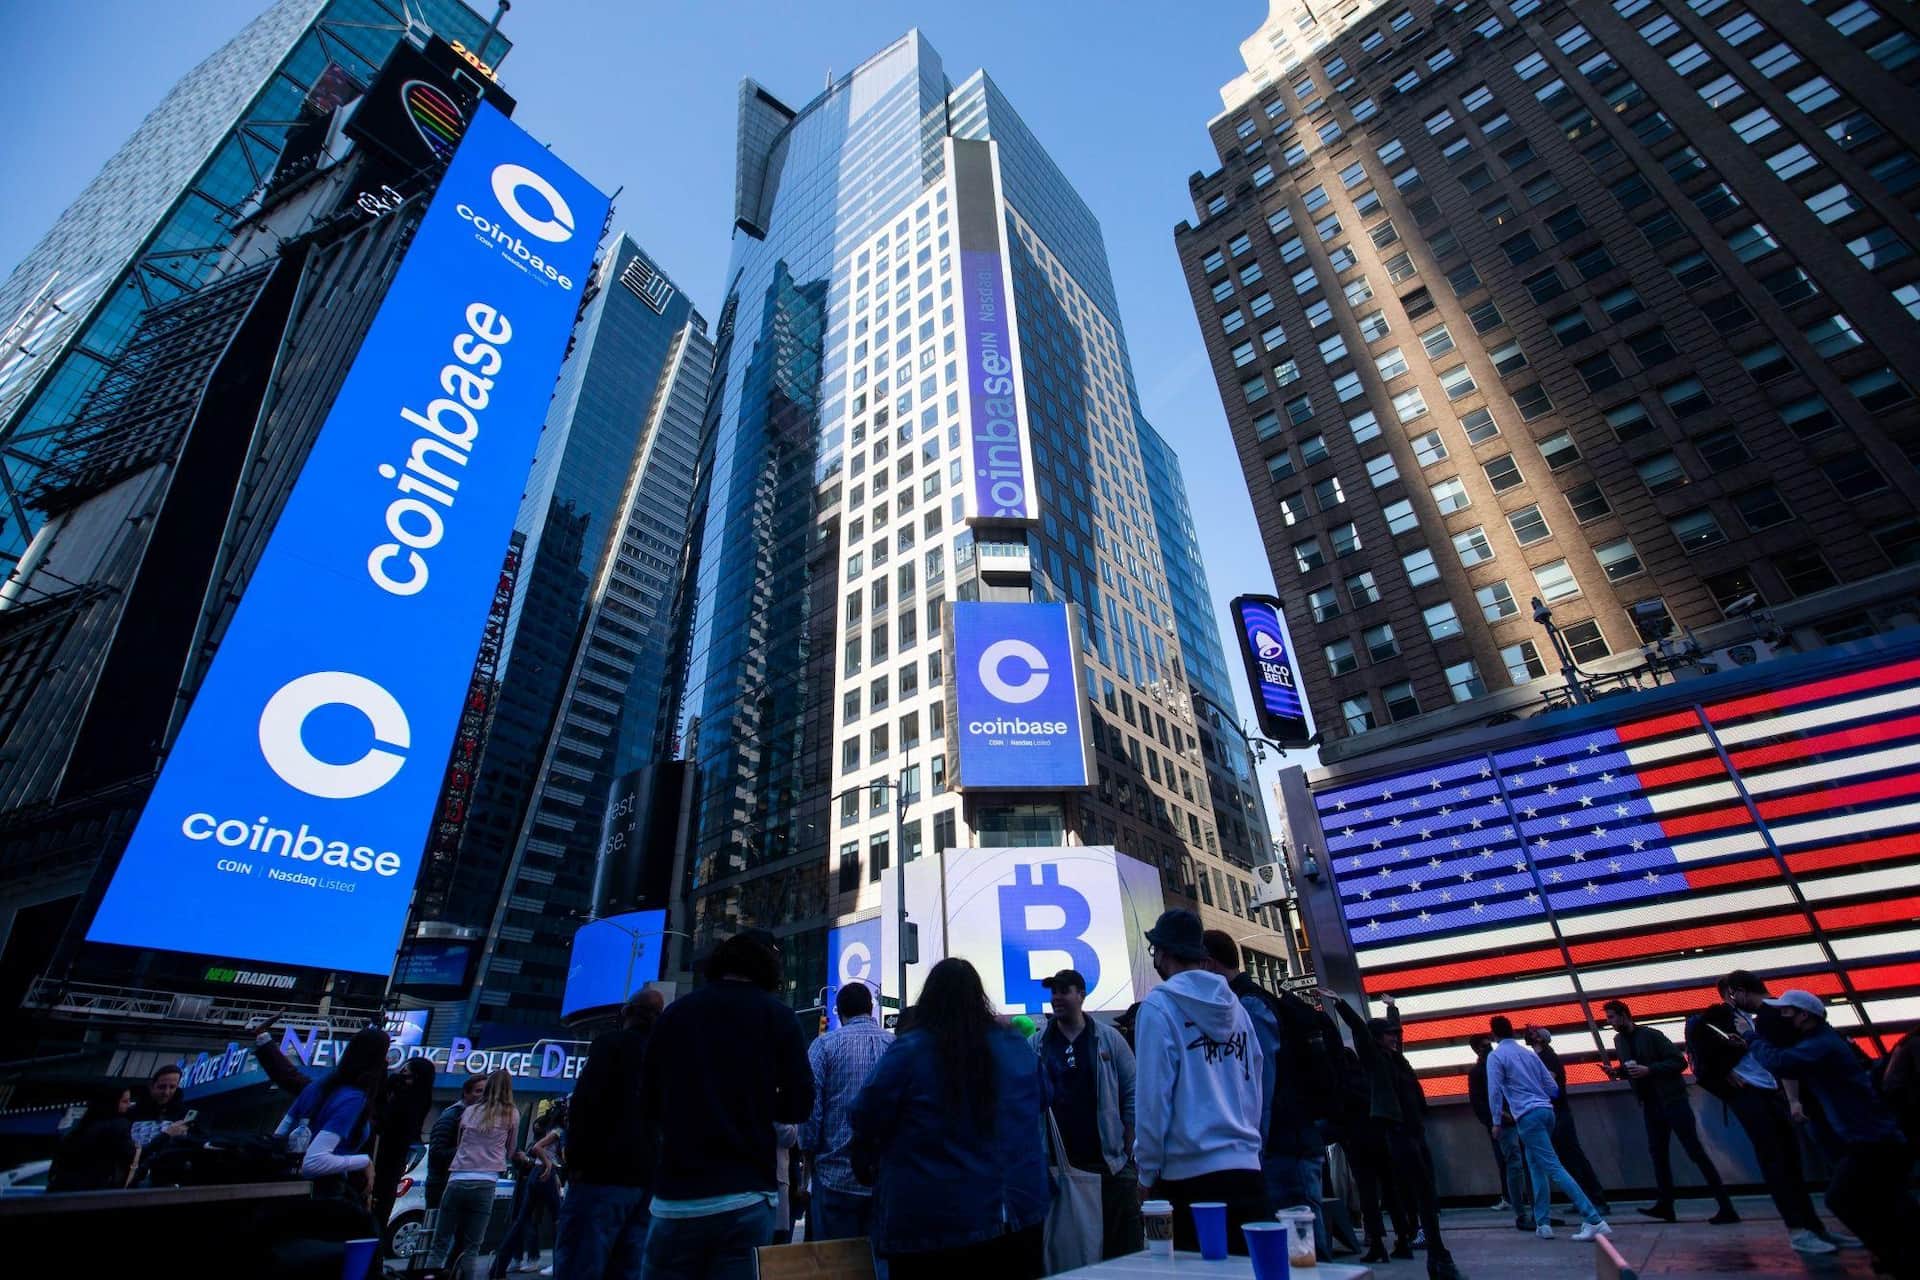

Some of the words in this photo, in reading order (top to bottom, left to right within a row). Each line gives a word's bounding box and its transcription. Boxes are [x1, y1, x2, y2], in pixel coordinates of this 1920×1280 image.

[450, 40, 498, 84] 2021
[456, 203, 573, 290] coinbase
[368, 302, 513, 596] coinbase
[1259, 660, 1290, 677] TACO
[1264, 671, 1293, 688] BELL
[969, 717, 1068, 735] coinbase
[182, 813, 401, 877] coinbase
[216, 859, 253, 875] COIN
[268, 868, 317, 888] Nasdaq
[318, 877, 355, 893] Listed
[217, 1042, 250, 1080] DEPT
[446, 1037, 531, 1076] POLICE
